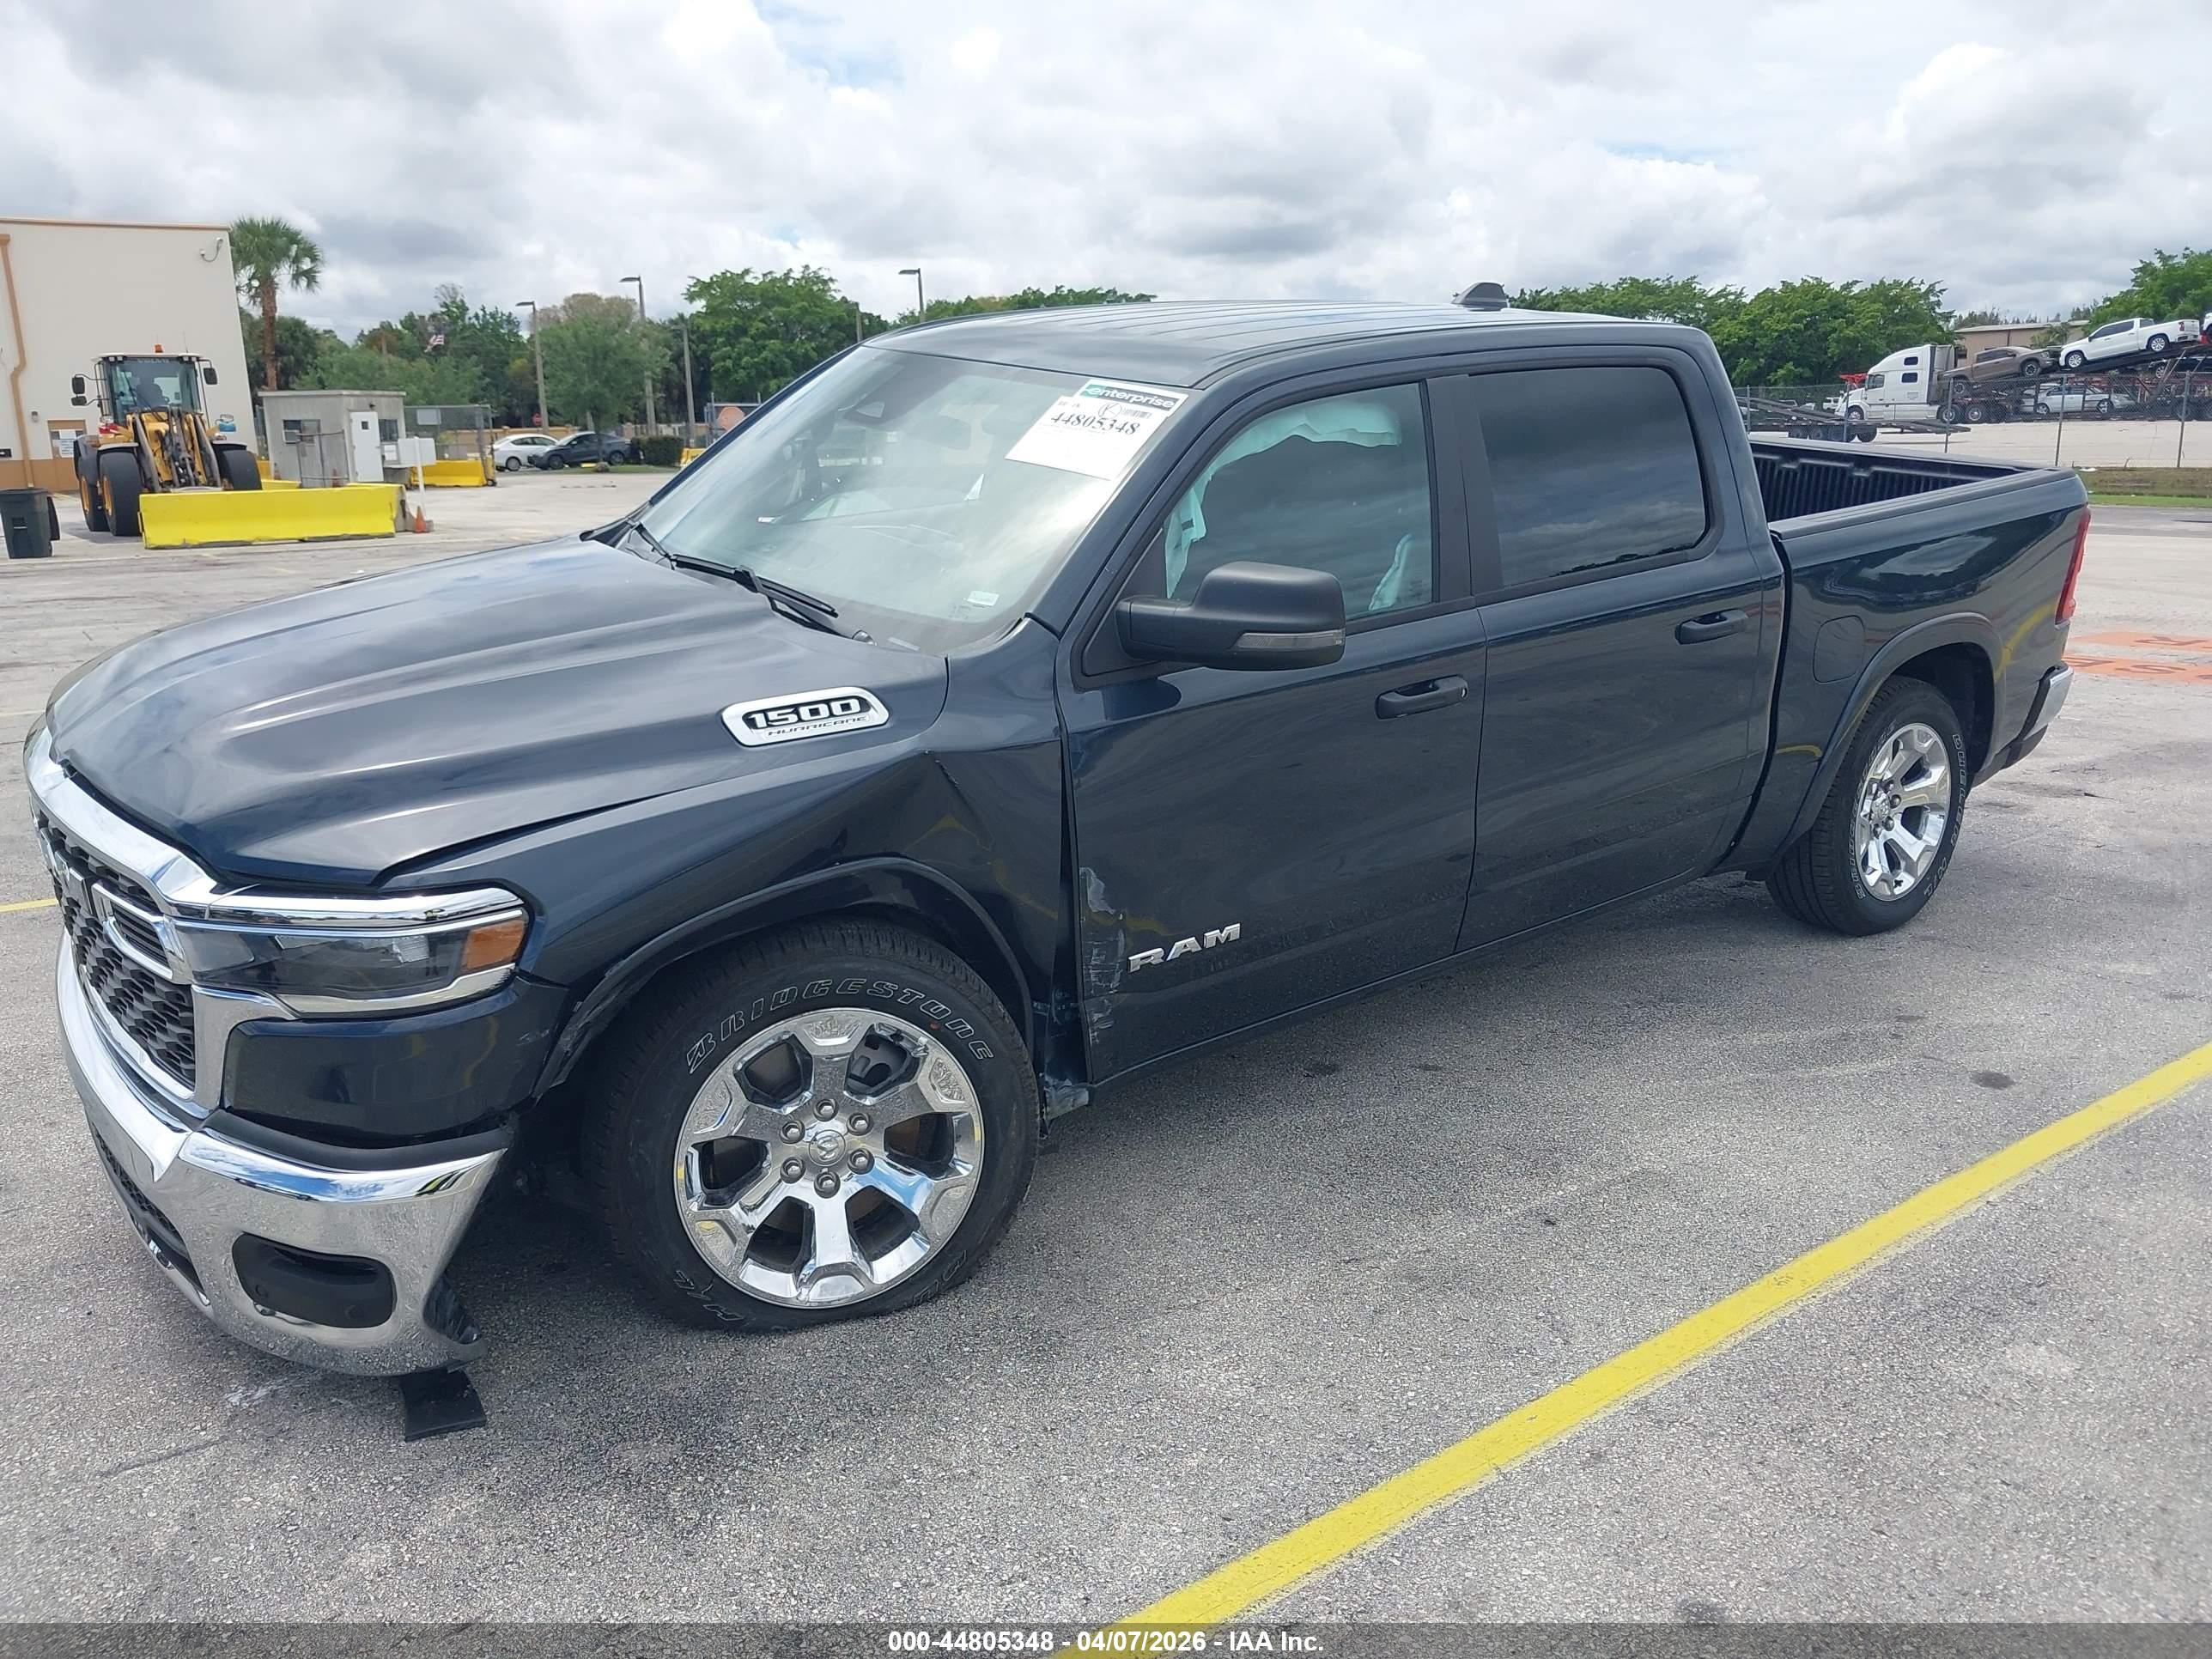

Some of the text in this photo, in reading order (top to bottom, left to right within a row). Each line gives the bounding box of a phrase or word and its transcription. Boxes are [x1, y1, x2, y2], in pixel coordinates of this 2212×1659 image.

[1086, 386, 1175, 408] enterprise
[1051, 412, 1140, 434] 44805348
[749, 698, 860, 728] 1500
[769, 716, 866, 736] HURRICANE
[1127, 923, 1241, 974] RAM
[686, 978, 994, 1073] BRIDGESTONE
